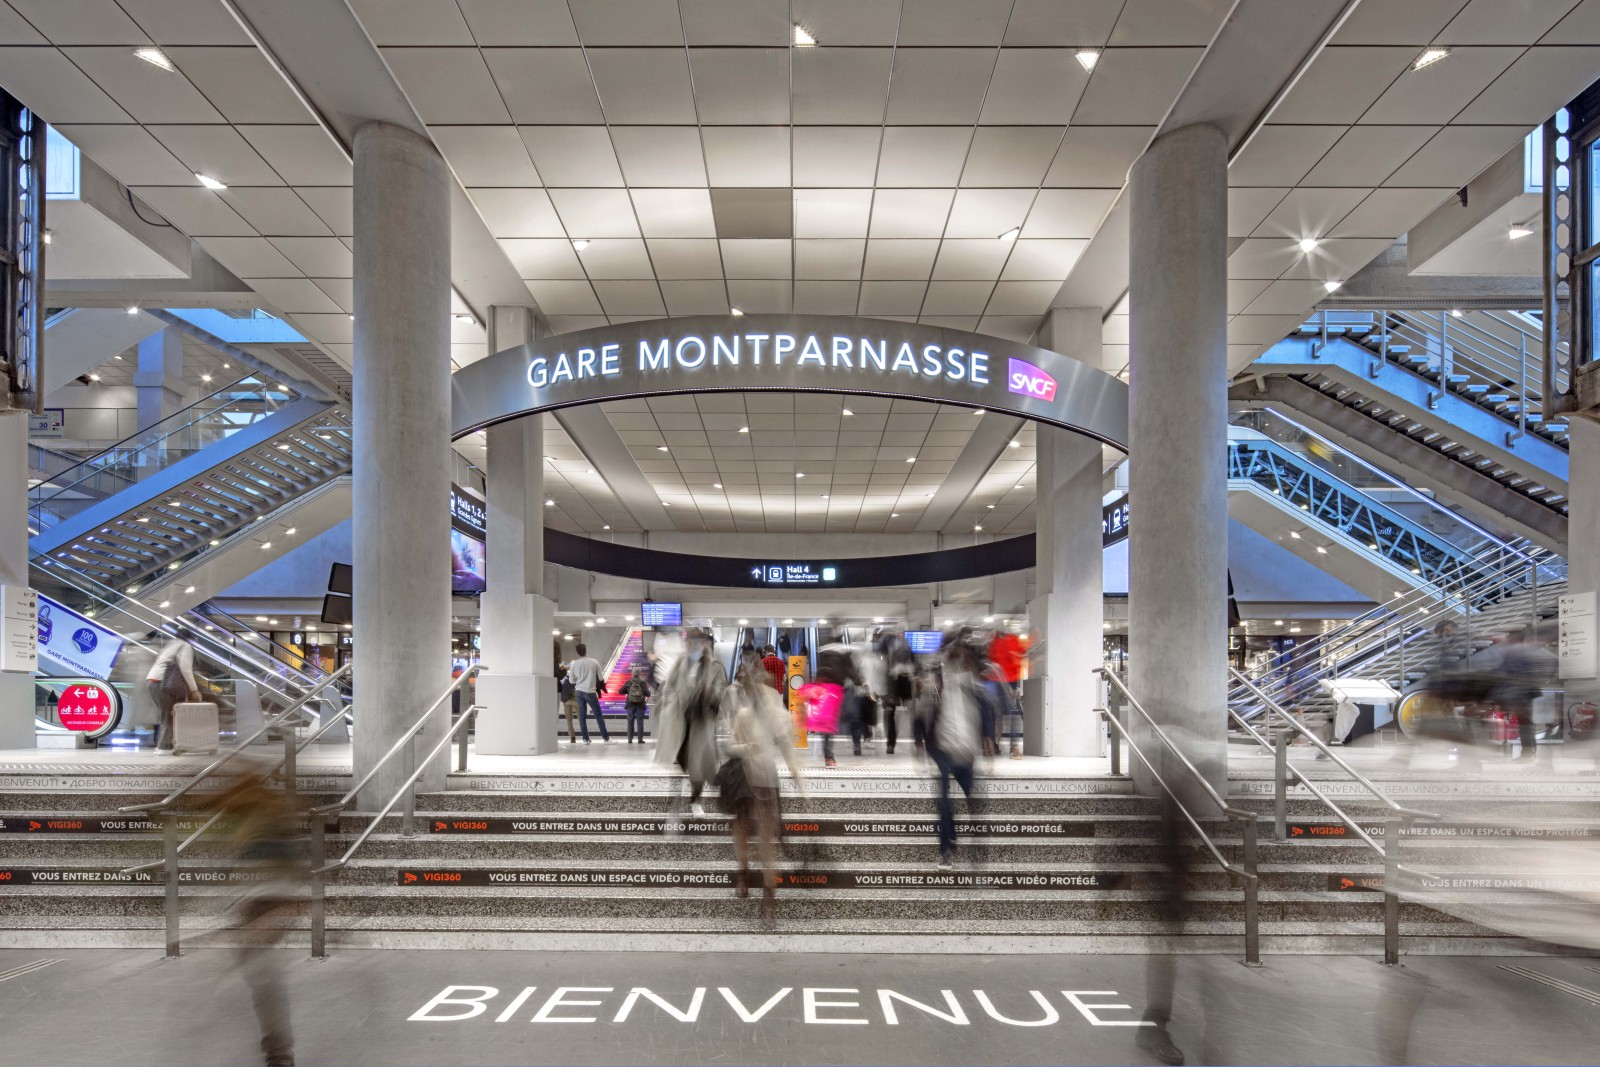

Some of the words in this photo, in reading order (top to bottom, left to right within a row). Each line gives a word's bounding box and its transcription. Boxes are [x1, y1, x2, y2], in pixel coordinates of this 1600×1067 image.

[526, 344, 621, 389] GARE
[637, 333, 990, 385] MONTPARNASSE
[1009, 371, 1053, 397] SNCF
[457, 495, 471, 512] Halls
[80, 629, 94, 641] 100
[47, 649, 62, 662] GARE
[61, 655, 104, 679] MONTPARNASSE
[70, 779, 106, 788] ДОБРО
[109, 780, 181, 788] ПОЖАЛОВАТЬ
[470, 780, 545, 790] BIENVENIDOS
[561, 781, 624, 790] BEM-VINDO
[779, 781, 834, 790] IENVENUE
[852, 782, 901, 790] WELKOM
[957, 783, 1019, 792] BNVENUTI
[1035, 783, 1113, 792] WILLKOMMEN
[1385, 785, 1449, 794] BEM-VINDO
[1514, 785, 1573, 794] WELCOME
[47, 821, 82, 829] VIGI360
[100, 821, 126, 829] VOUS
[128, 821, 164, 829] ENTREZ
[452, 822, 488, 830] VIGI360
[512, 822, 538, 830] VOUS
[540, 822, 575, 830] ENTREZ
[621, 823, 655, 831] ESPACE
[657, 822, 686, 831] VIDÉO
[688, 822, 733, 831] PROTÉGÉ.
[784, 824, 819, 832] VIGI360
[844, 824, 870, 832] VOUS
[872, 824, 906, 832] ENTREZ
[955, 825, 988, 833] ESPACE
[990, 823, 1019, 833] VIDÉO
[1021, 824, 1065, 833] PROTÉGÉ.
[1309, 827, 1345, 835] VIGI360
[1364, 827, 1385, 835] VOU
[1430, 828, 1457, 836] DANS
[1514, 828, 1544, 836] VIDÉO
[31, 872, 60, 881] VOUS
[63, 872, 101, 881] ENTREZ
[135, 873, 151, 881] UN
[194, 871, 227, 881] VIDÉO
[423, 873, 462, 882] VIGI360
[489, 873, 517, 882] VOUS
[519, 873, 558, 882] ENTREZ
[560, 874, 588, 882] DANS
[591, 874, 606, 882] UN
[609, 874, 646, 882] ESPACE
[649, 872, 681, 882] VIDÉO
[683, 873, 732, 883] PROTÉGÉ.
[789, 875, 828, 884] VIGI360
[855, 876, 884, 884] VOUS
[886, 876, 924, 884] ENTREZ
[926, 876, 955, 884] DANS
[957, 876, 973, 884] UN
[975, 876, 1013, 885] ESPACE
[1016, 875, 1047, 885] VIDÉO
[1050, 875, 1099, 885] PROTÉGÉ.
[1452, 879, 1492, 887] ENTREZ
[1527, 880, 1542, 888] UN
[405, 984, 1159, 1027] BIENVENUE
